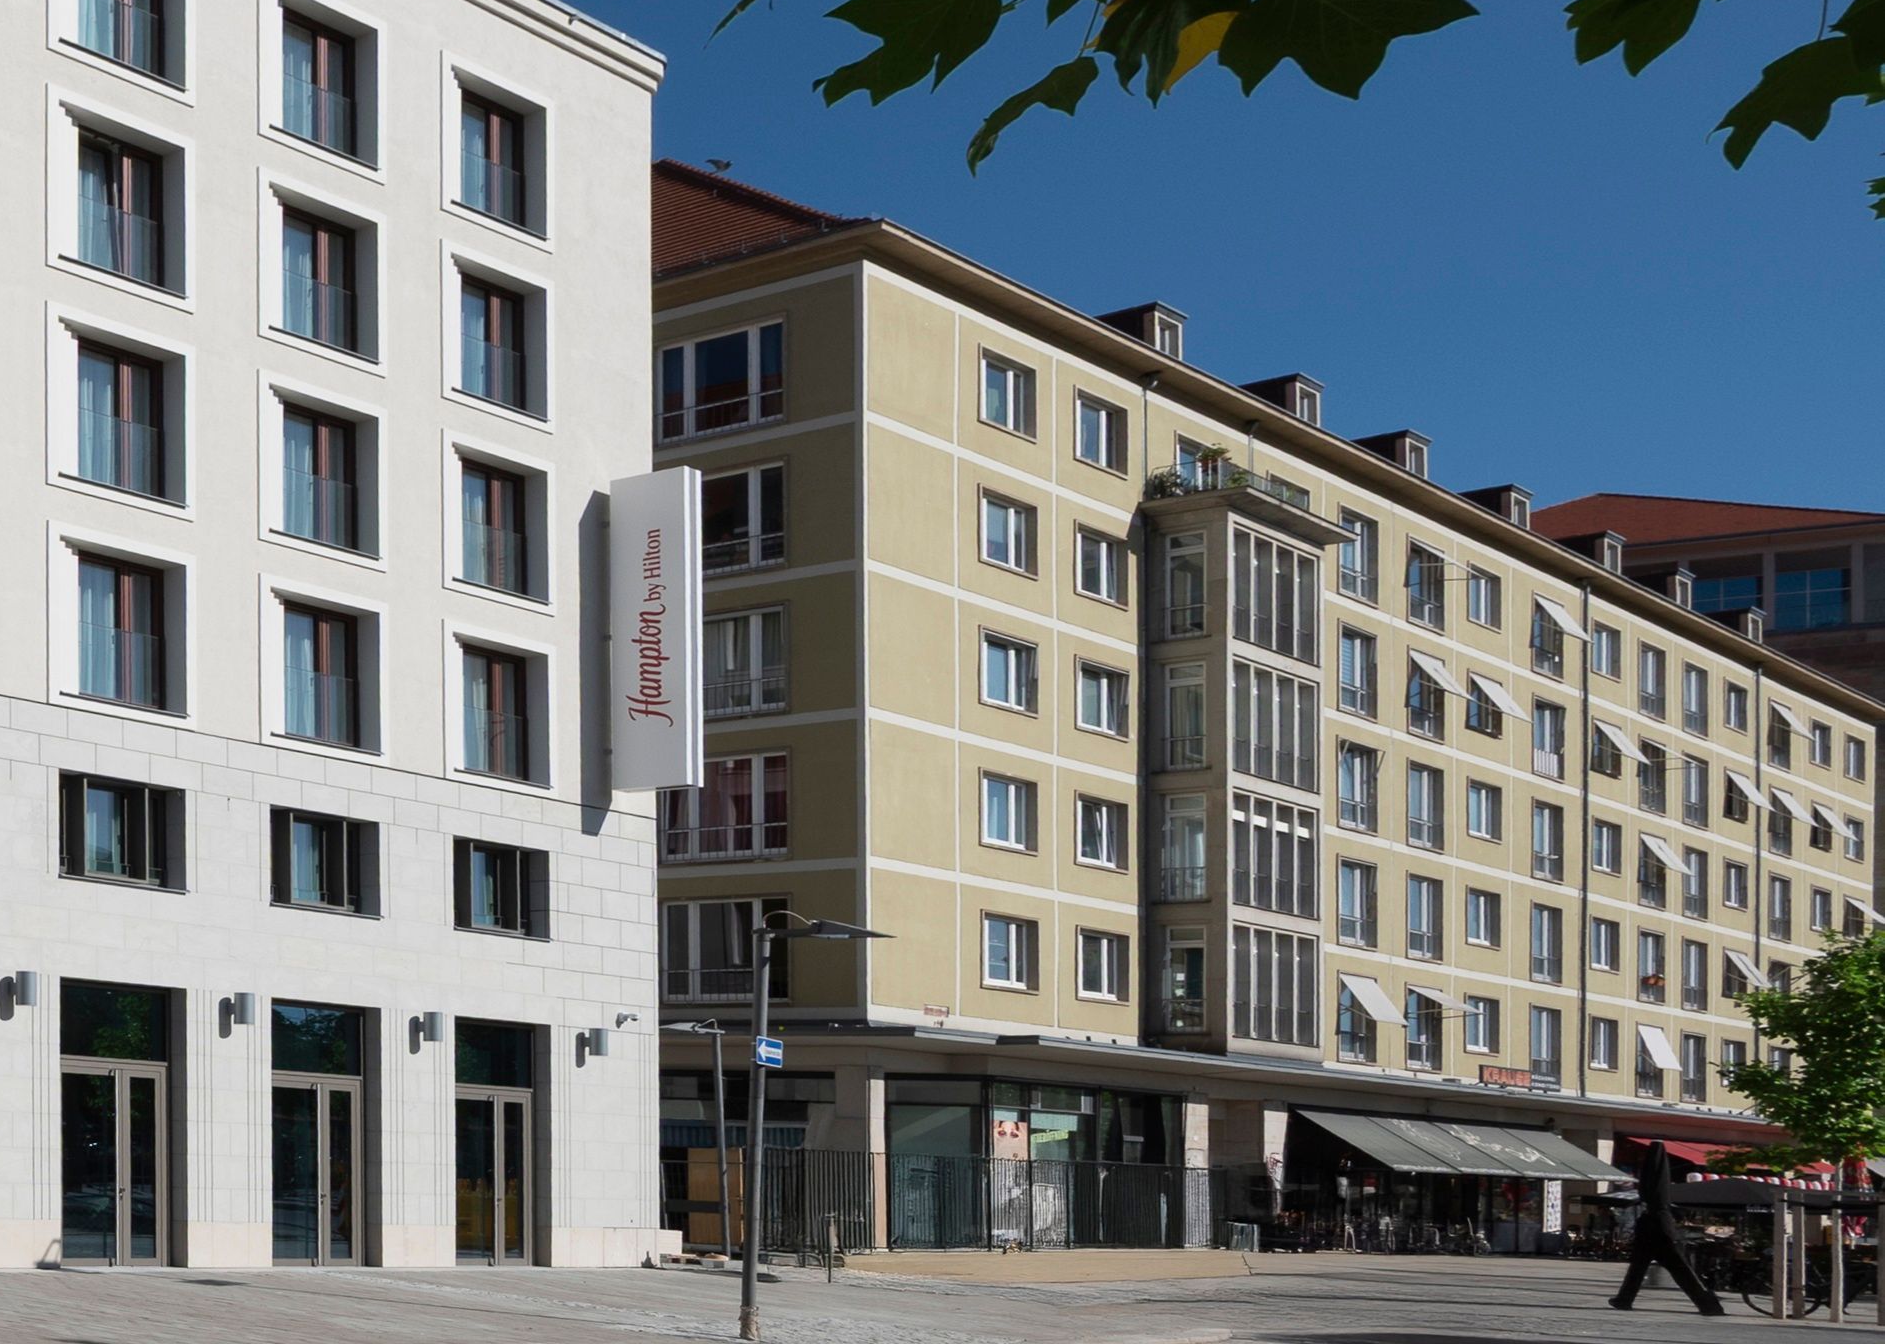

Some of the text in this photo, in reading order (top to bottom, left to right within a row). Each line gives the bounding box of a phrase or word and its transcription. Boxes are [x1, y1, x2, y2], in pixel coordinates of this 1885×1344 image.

[625, 528, 673, 727] Hampton by Hilton
